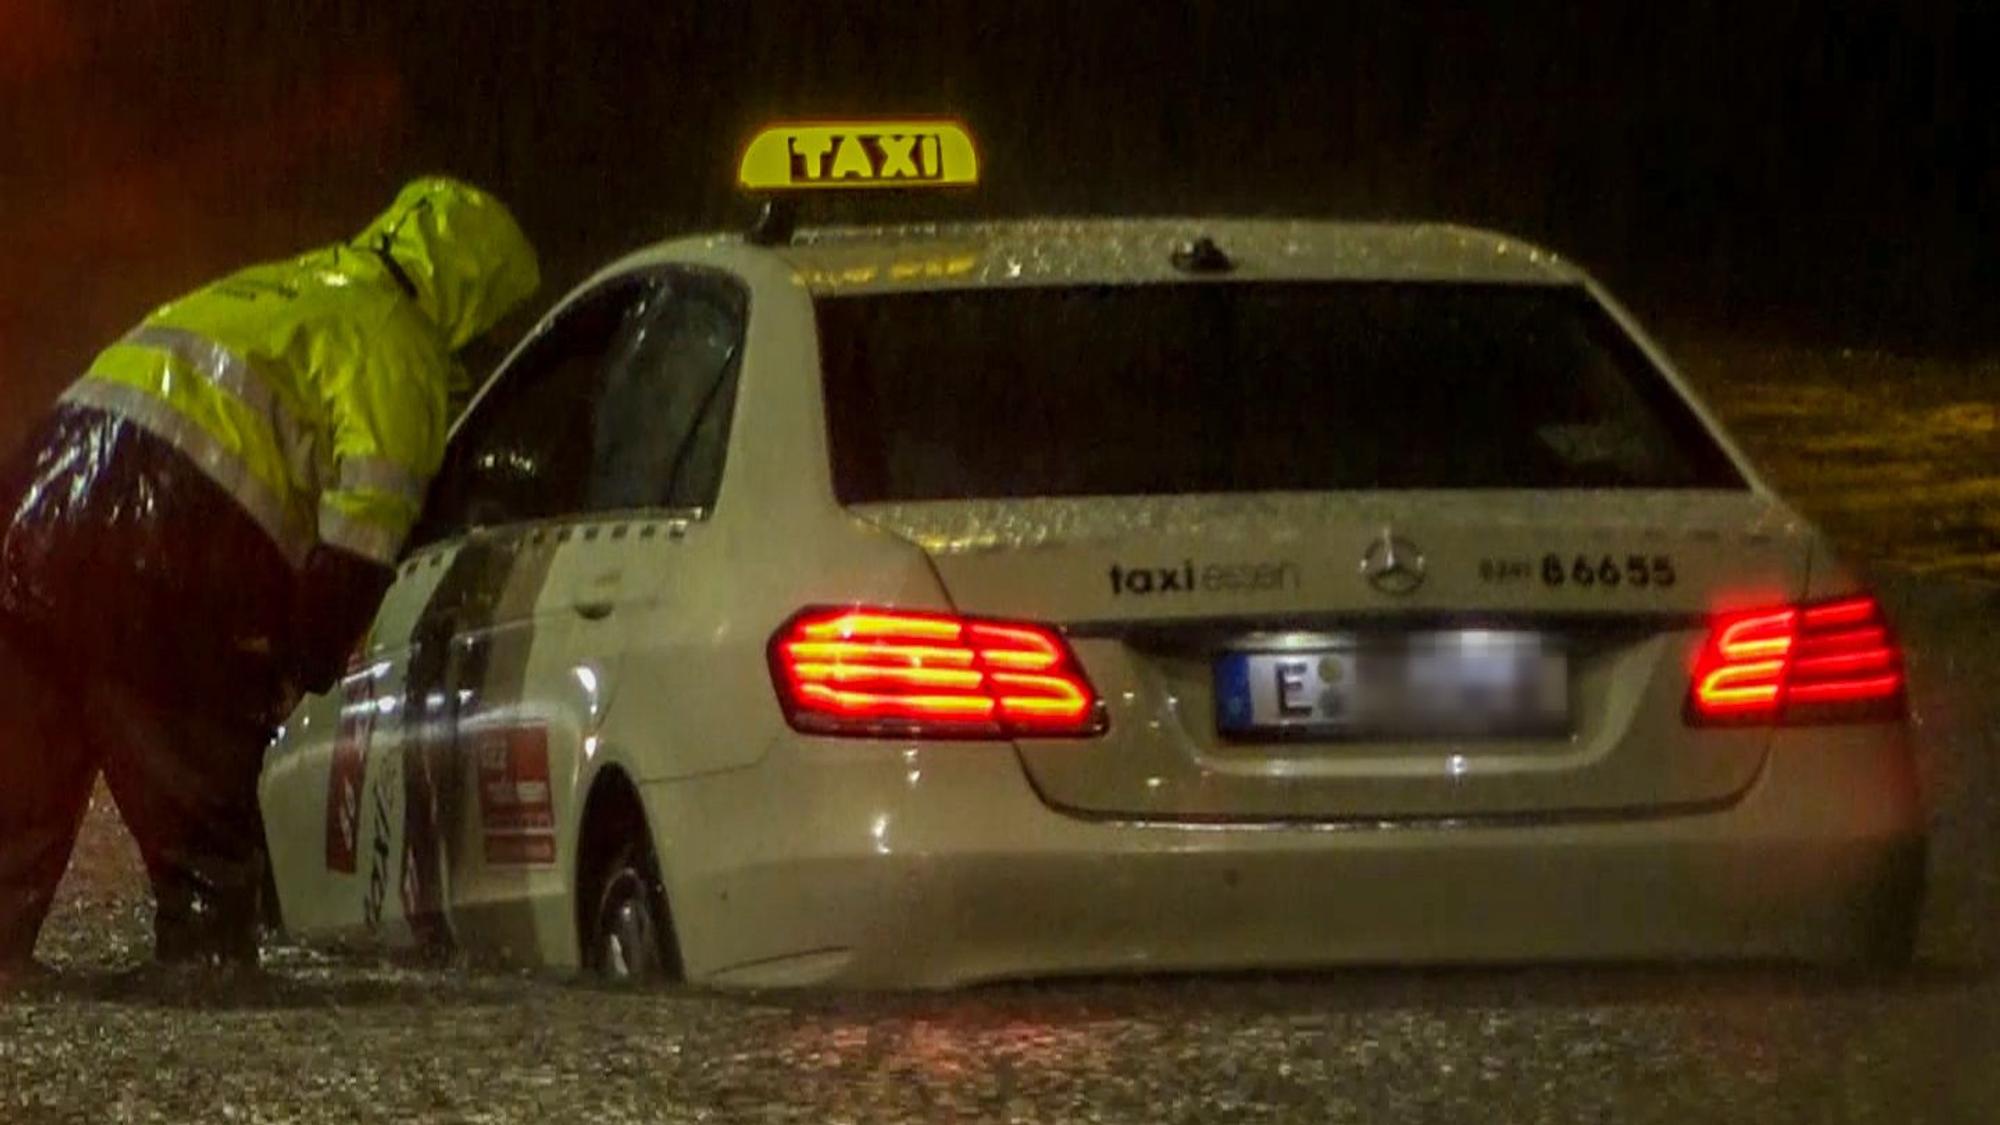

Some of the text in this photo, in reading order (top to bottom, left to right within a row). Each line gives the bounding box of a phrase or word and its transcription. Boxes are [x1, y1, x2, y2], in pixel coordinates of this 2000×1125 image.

[790, 135, 942, 181] TAXI
[1109, 557, 1195, 596] taxi
[1541, 553, 1677, 587] 86655
[1273, 661, 1313, 717] E
